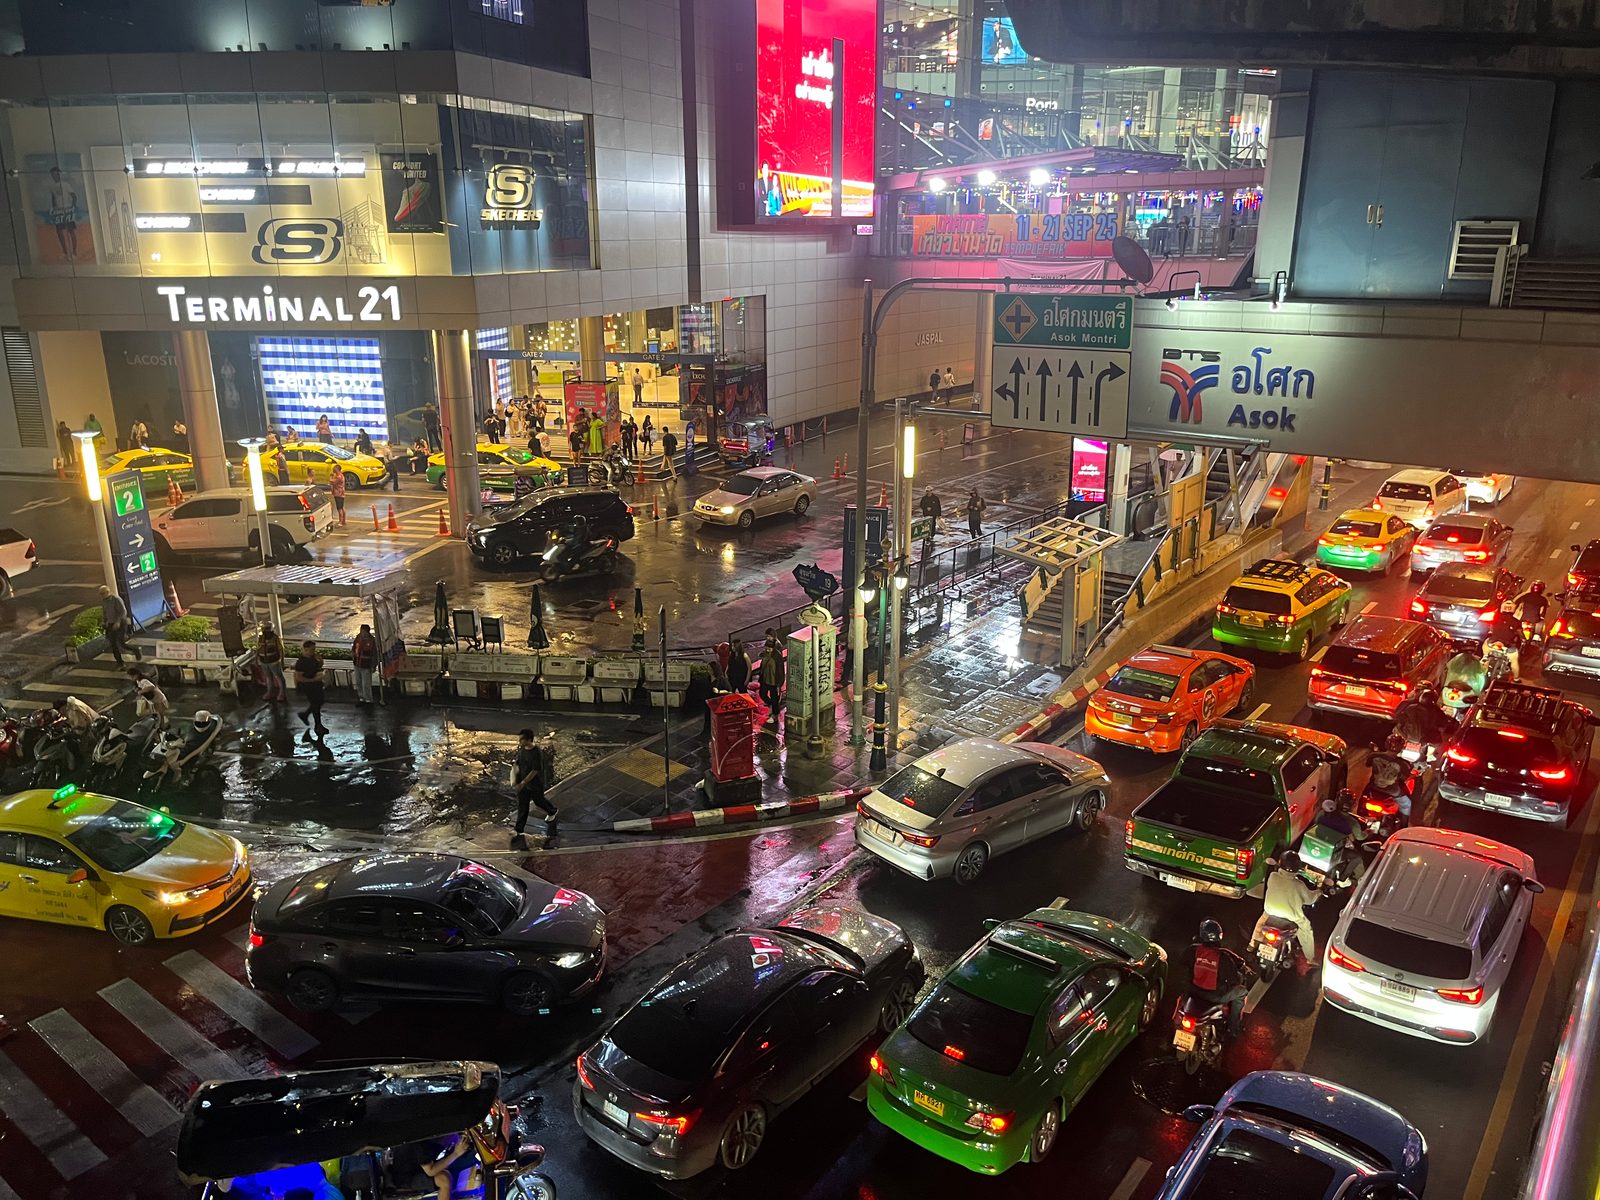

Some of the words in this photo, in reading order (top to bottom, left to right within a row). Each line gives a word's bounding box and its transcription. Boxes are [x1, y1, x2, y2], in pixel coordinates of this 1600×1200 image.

[480, 208, 544, 221] SKECHERS
[1016, 215, 1030, 241] 11
[1043, 215, 1060, 241] 21
[1064, 214, 1094, 241] SEP
[1096, 213, 1118, 241] 25
[357, 285, 401, 321] 21
[1043, 296, 1126, 330] อโศกมนตรี
[915, 330, 943, 346] JASPAL
[1050, 333, 1077, 343] Asok
[1081, 333, 1117, 344] Montri
[642, 353, 660, 361] GATE
[1162, 348, 1222, 362] BTS
[1231, 346, 1316, 400] อโศก
[1226, 403, 1296, 432] Asok
[122, 491, 136, 512] 2
[144, 559, 152, 571] 2
[1161, 846, 1205, 864] เทศกิจ
